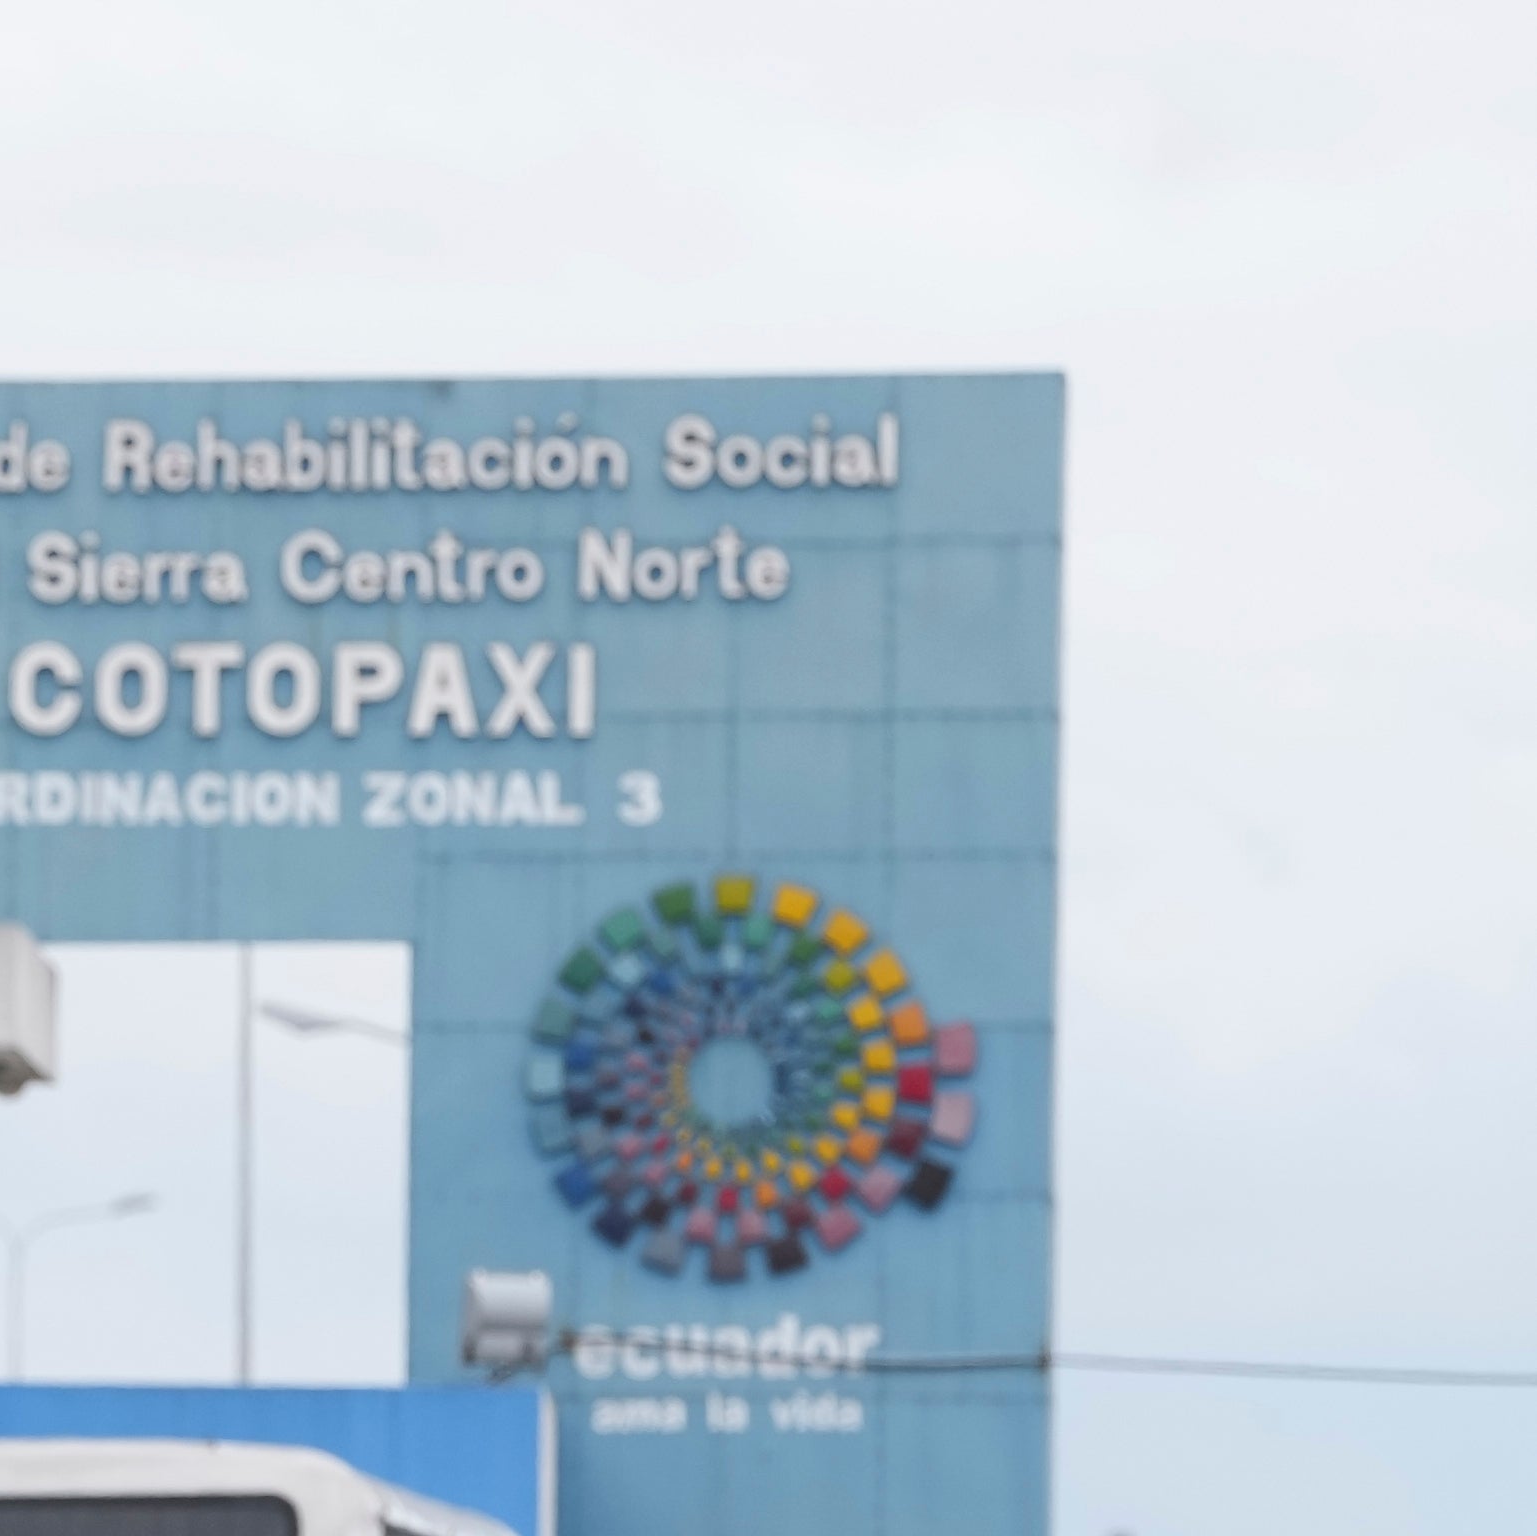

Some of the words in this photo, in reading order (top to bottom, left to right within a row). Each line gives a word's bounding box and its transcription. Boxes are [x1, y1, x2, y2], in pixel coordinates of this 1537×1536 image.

[103, 414, 628, 490] Rehabilitación
[664, 412, 899, 487] Social
[27, 529, 248, 602] Sierra
[281, 528, 544, 602] Centro
[579, 525, 790, 600] Norte
[9, 639, 596, 737] COTOPAXI
[619, 771, 664, 825] 3
[574, 1312, 881, 1381] ecuador
[591, 1397, 688, 1433] ama
[706, 1393, 750, 1433] la
[770, 1391, 865, 1433] vida
